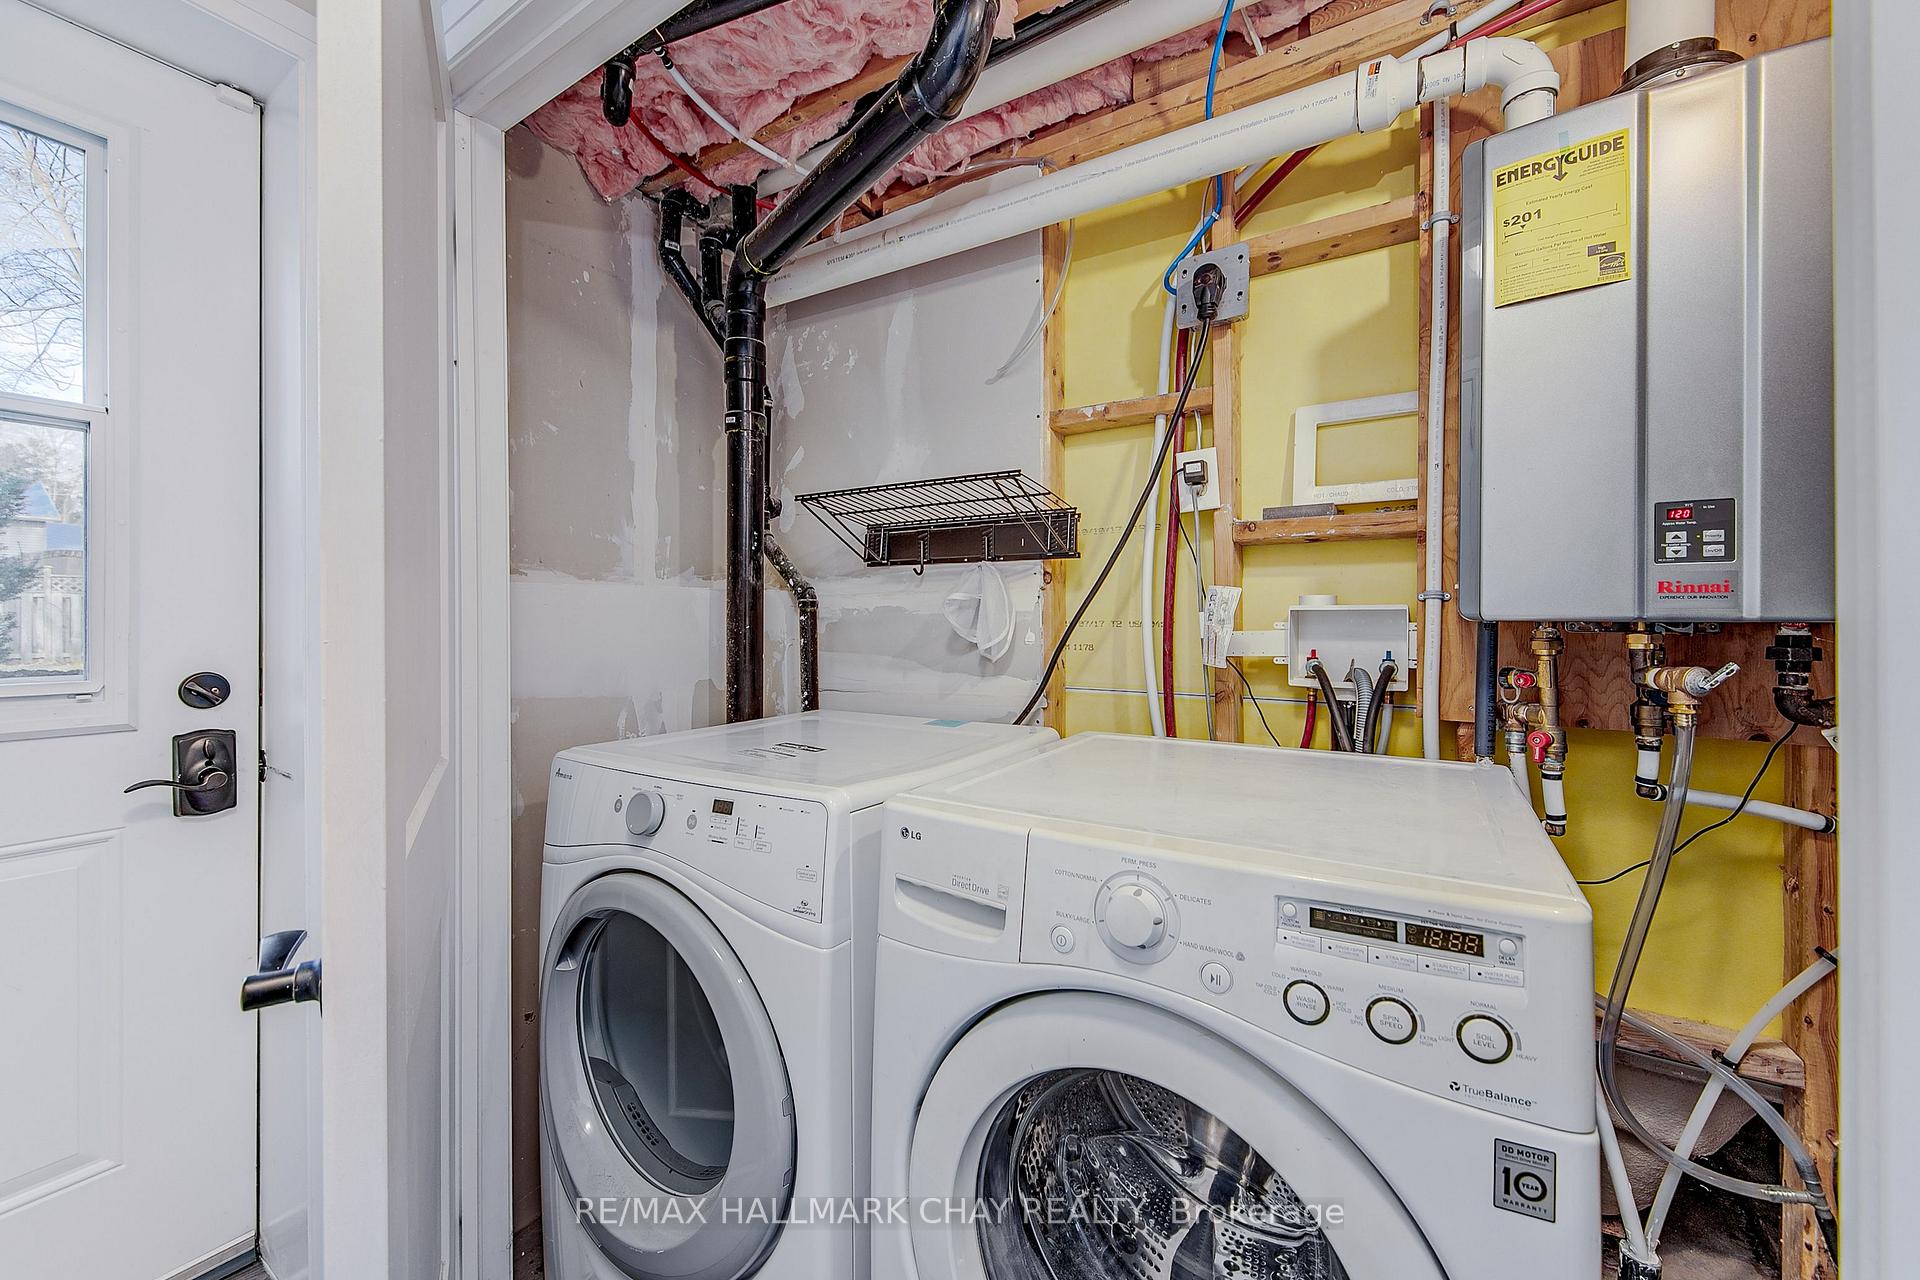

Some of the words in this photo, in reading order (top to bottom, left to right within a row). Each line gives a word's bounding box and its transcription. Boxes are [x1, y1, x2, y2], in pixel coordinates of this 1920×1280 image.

[1497, 136, 1624, 187] ENERGYGUIDE
[1563, 187, 1580, 196] Energy
[1503, 208, 1542, 228] $201
[1671, 509, 1690, 518] 120
[1138, 860, 1157, 869] PRESS
[1179, 893, 1212, 905] DELICATES
[1378, 984, 1404, 993] MEDIUM
[1296, 994, 1317, 1004] WASH
[1470, 1000, 1498, 1010] NORMAL
[1382, 1014, 1400, 1023] SPIN
[1380, 1020, 1404, 1030] SPEED
[1476, 1033, 1493, 1042] SOIL
[1473, 1039, 1497, 1049] LEVEL
[1516, 1053, 1537, 1063] HEAVY
[1501, 1145, 1514, 1154] DD
[1517, 1149, 1550, 1163] MOTOR
[1502, 1166, 1548, 1202] 10
[1521, 1183, 1540, 1192] YEAR
[1503, 1198, 1548, 1214] WARRANTY
